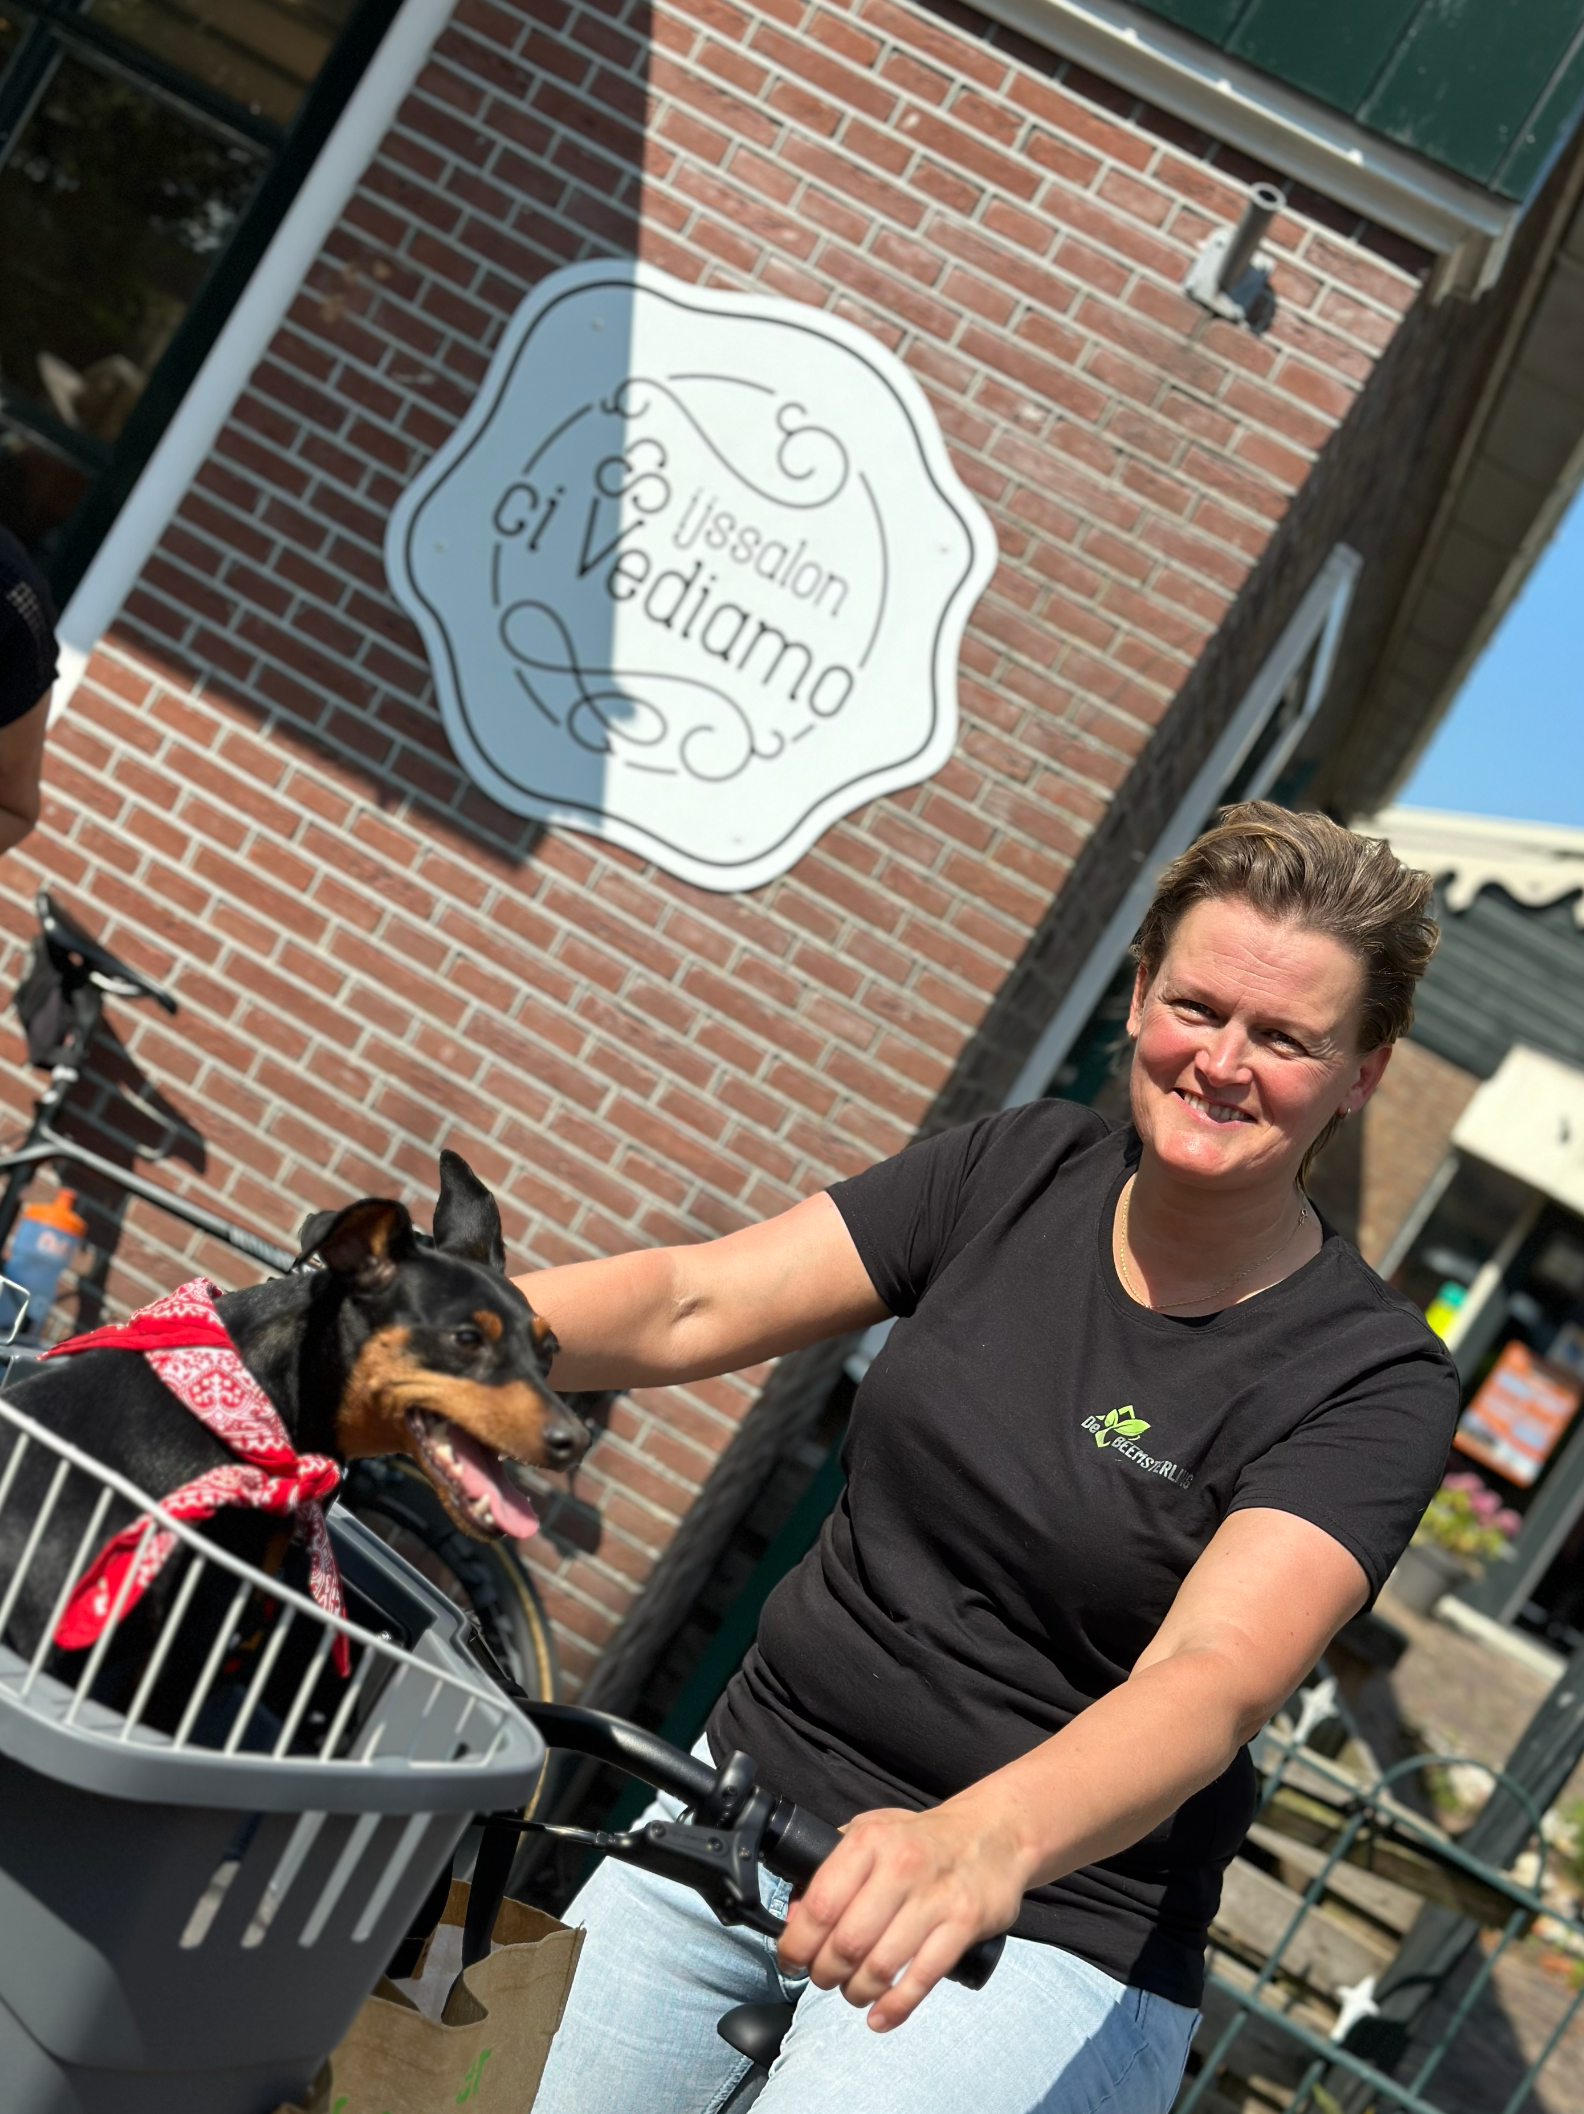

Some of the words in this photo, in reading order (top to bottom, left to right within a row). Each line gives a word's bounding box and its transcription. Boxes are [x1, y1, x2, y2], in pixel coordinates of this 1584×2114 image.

[577, 496, 855, 718] Vediamo
[1080, 1415, 1101, 1434] De
[1111, 1436, 1194, 1490] BEEMSTERLING
